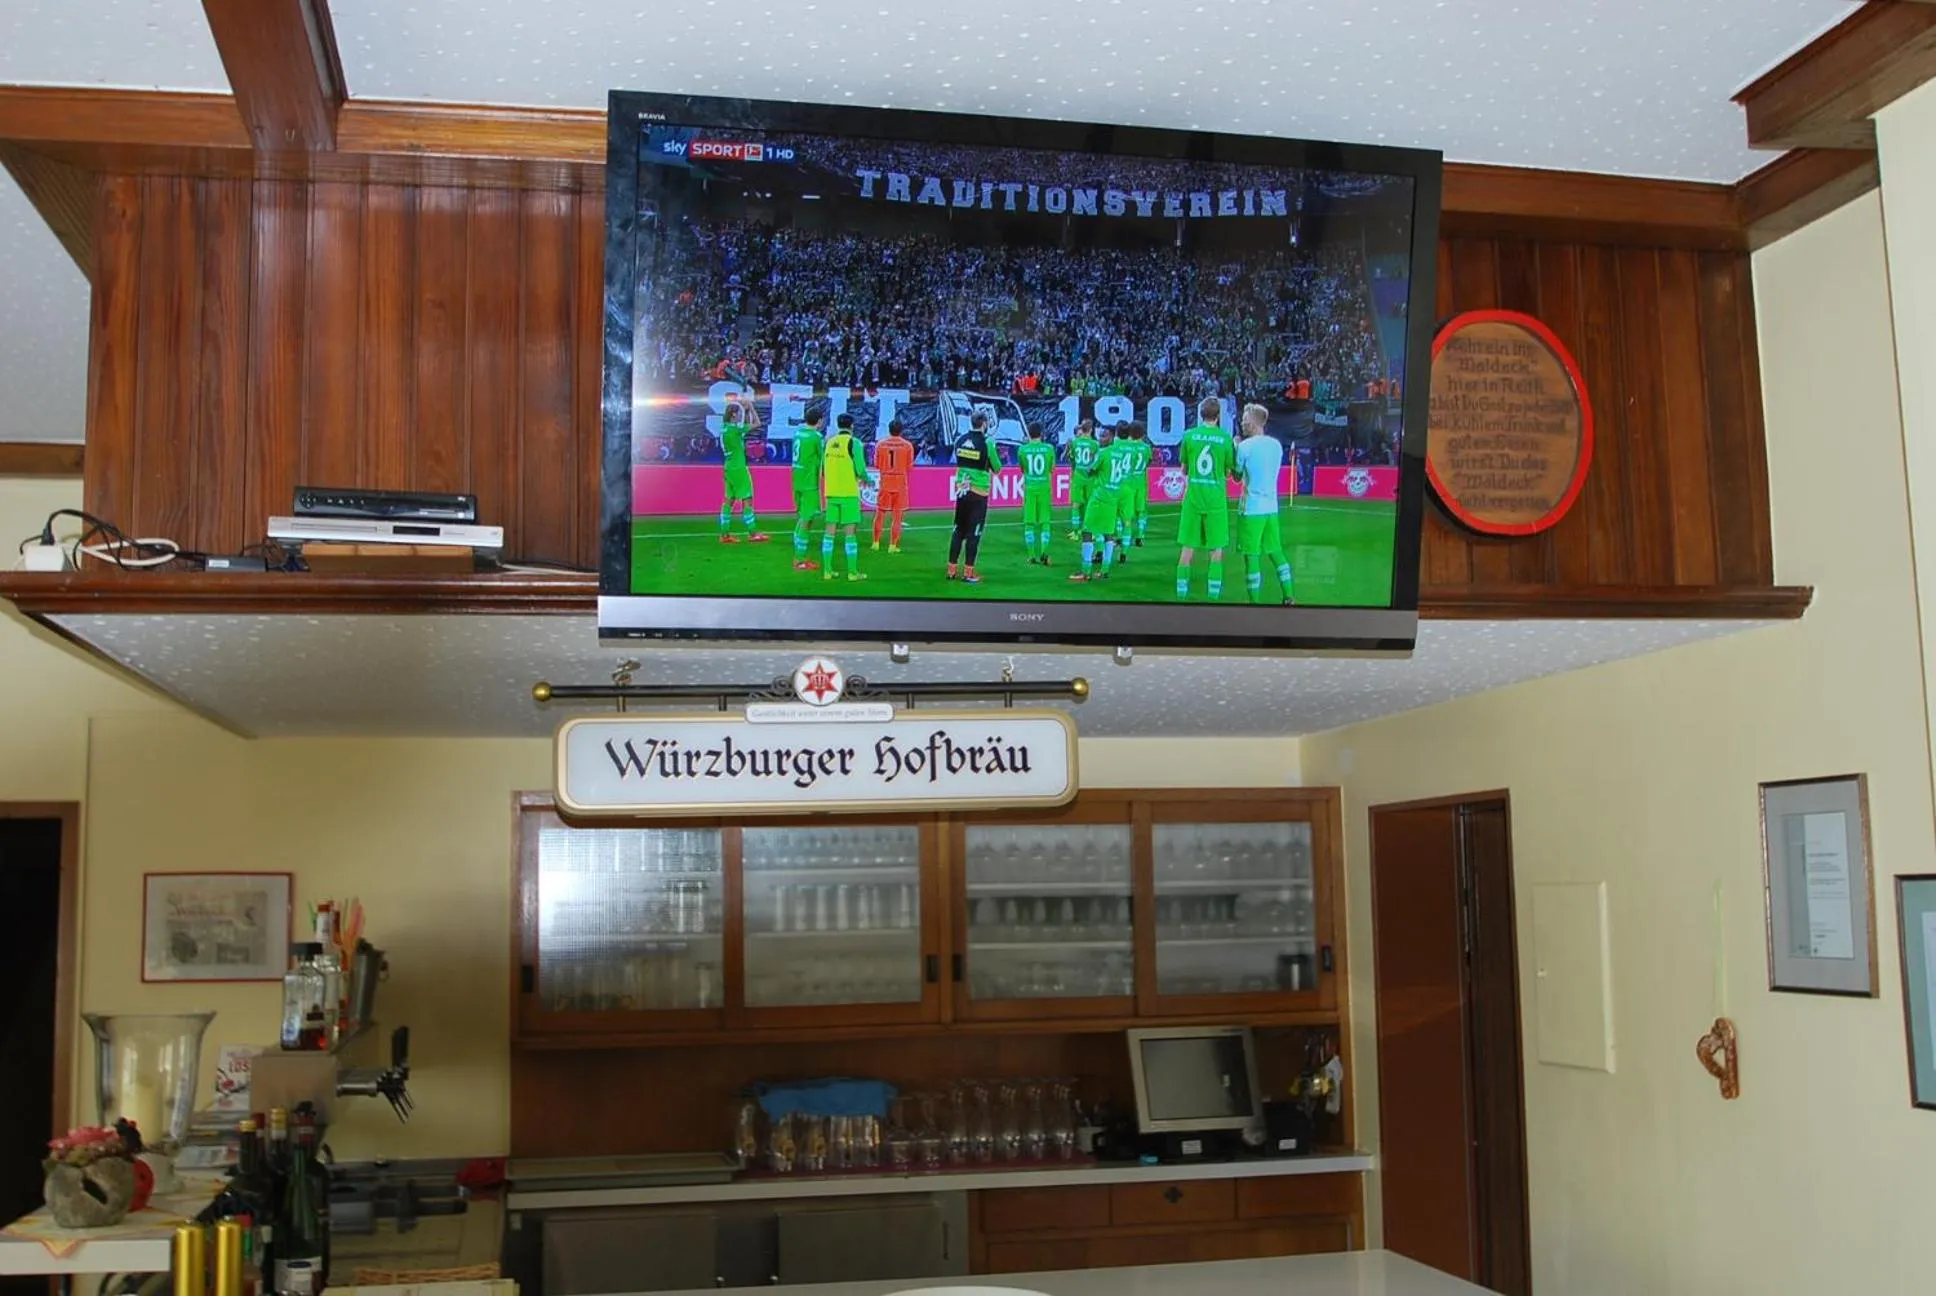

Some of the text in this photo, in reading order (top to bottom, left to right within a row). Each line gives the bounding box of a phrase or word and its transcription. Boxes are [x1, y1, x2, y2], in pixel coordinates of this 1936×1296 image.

[663, 141, 687, 155] sky
[692, 143, 742, 157] SPORT
[776, 149, 794, 159] HD
[856, 168, 1287, 217] TRADITIONSVEREIN
[1026, 453, 1045, 476] 10
[1075, 448, 1090, 464] 30
[1196, 445, 1213, 476] 6
[1010, 613, 1045, 621] SONY
[605, 730, 1032, 789] Würzburger Hofbräu
